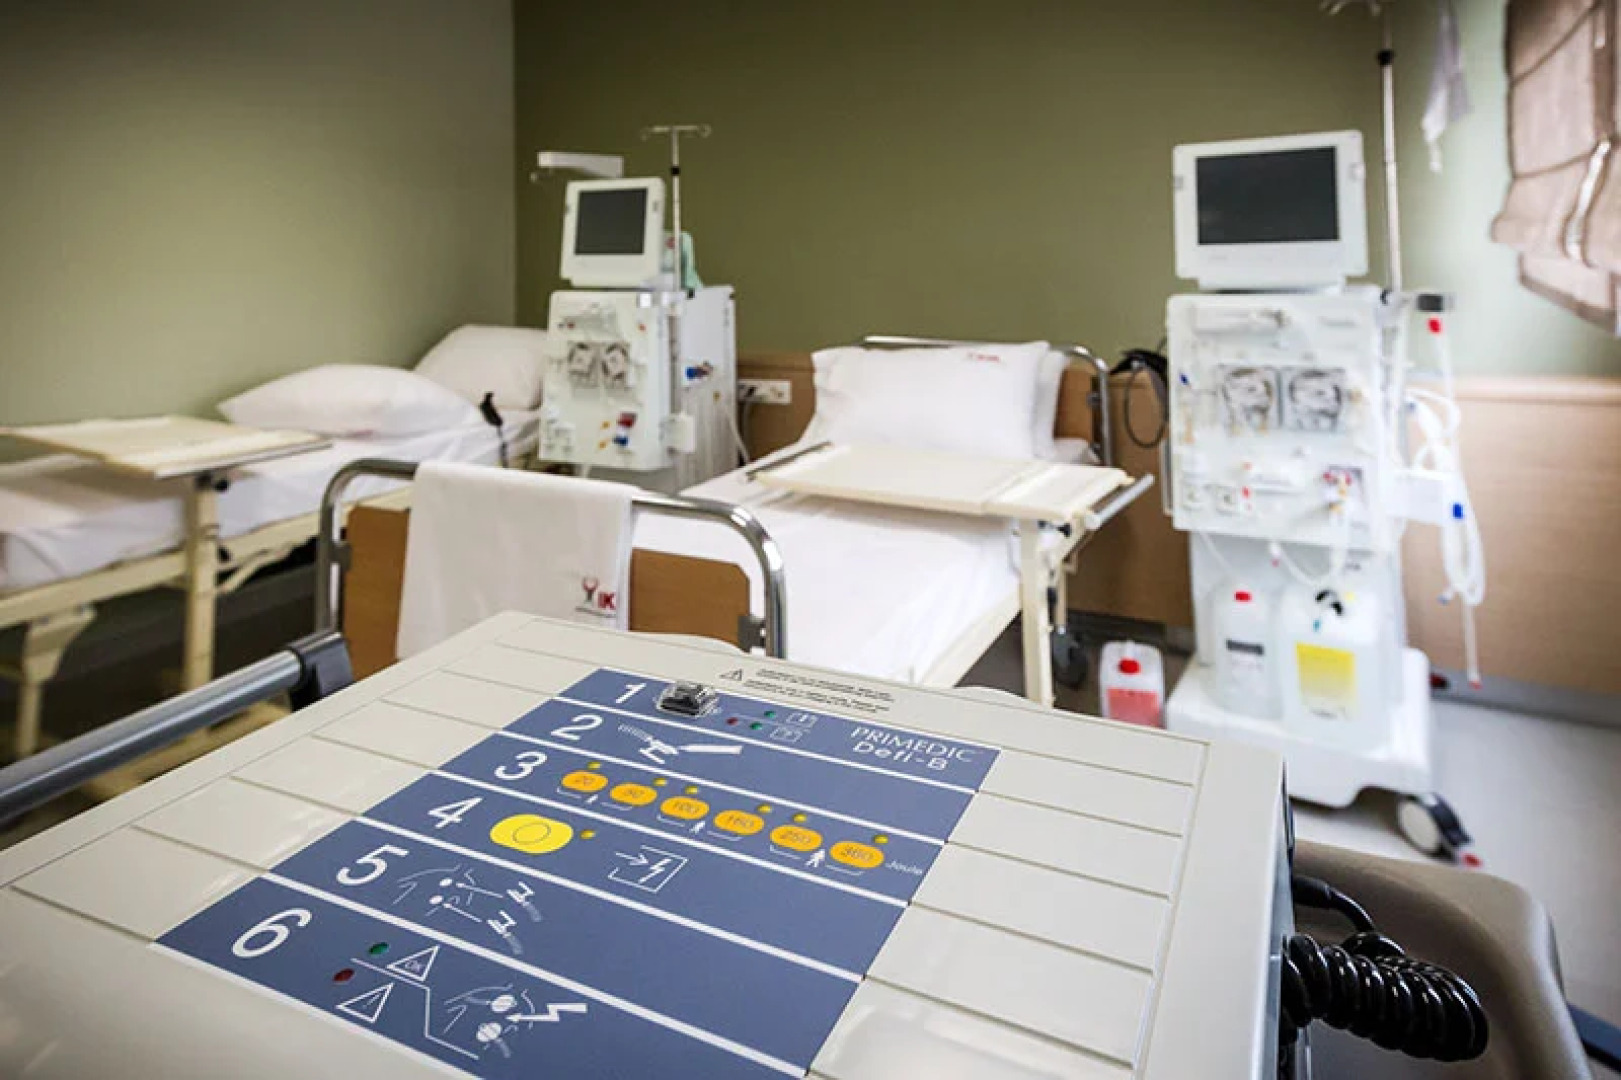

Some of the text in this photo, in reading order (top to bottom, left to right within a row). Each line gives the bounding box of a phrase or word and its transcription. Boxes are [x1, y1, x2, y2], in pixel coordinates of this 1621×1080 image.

[615, 682, 646, 704] 1
[550, 714, 603, 741] 2
[851, 726, 976, 762] PRIMEDIC
[494, 751, 547, 780] 3
[427, 797, 483, 829] 4
[336, 844, 410, 887] 5
[232, 908, 313, 959] 6
